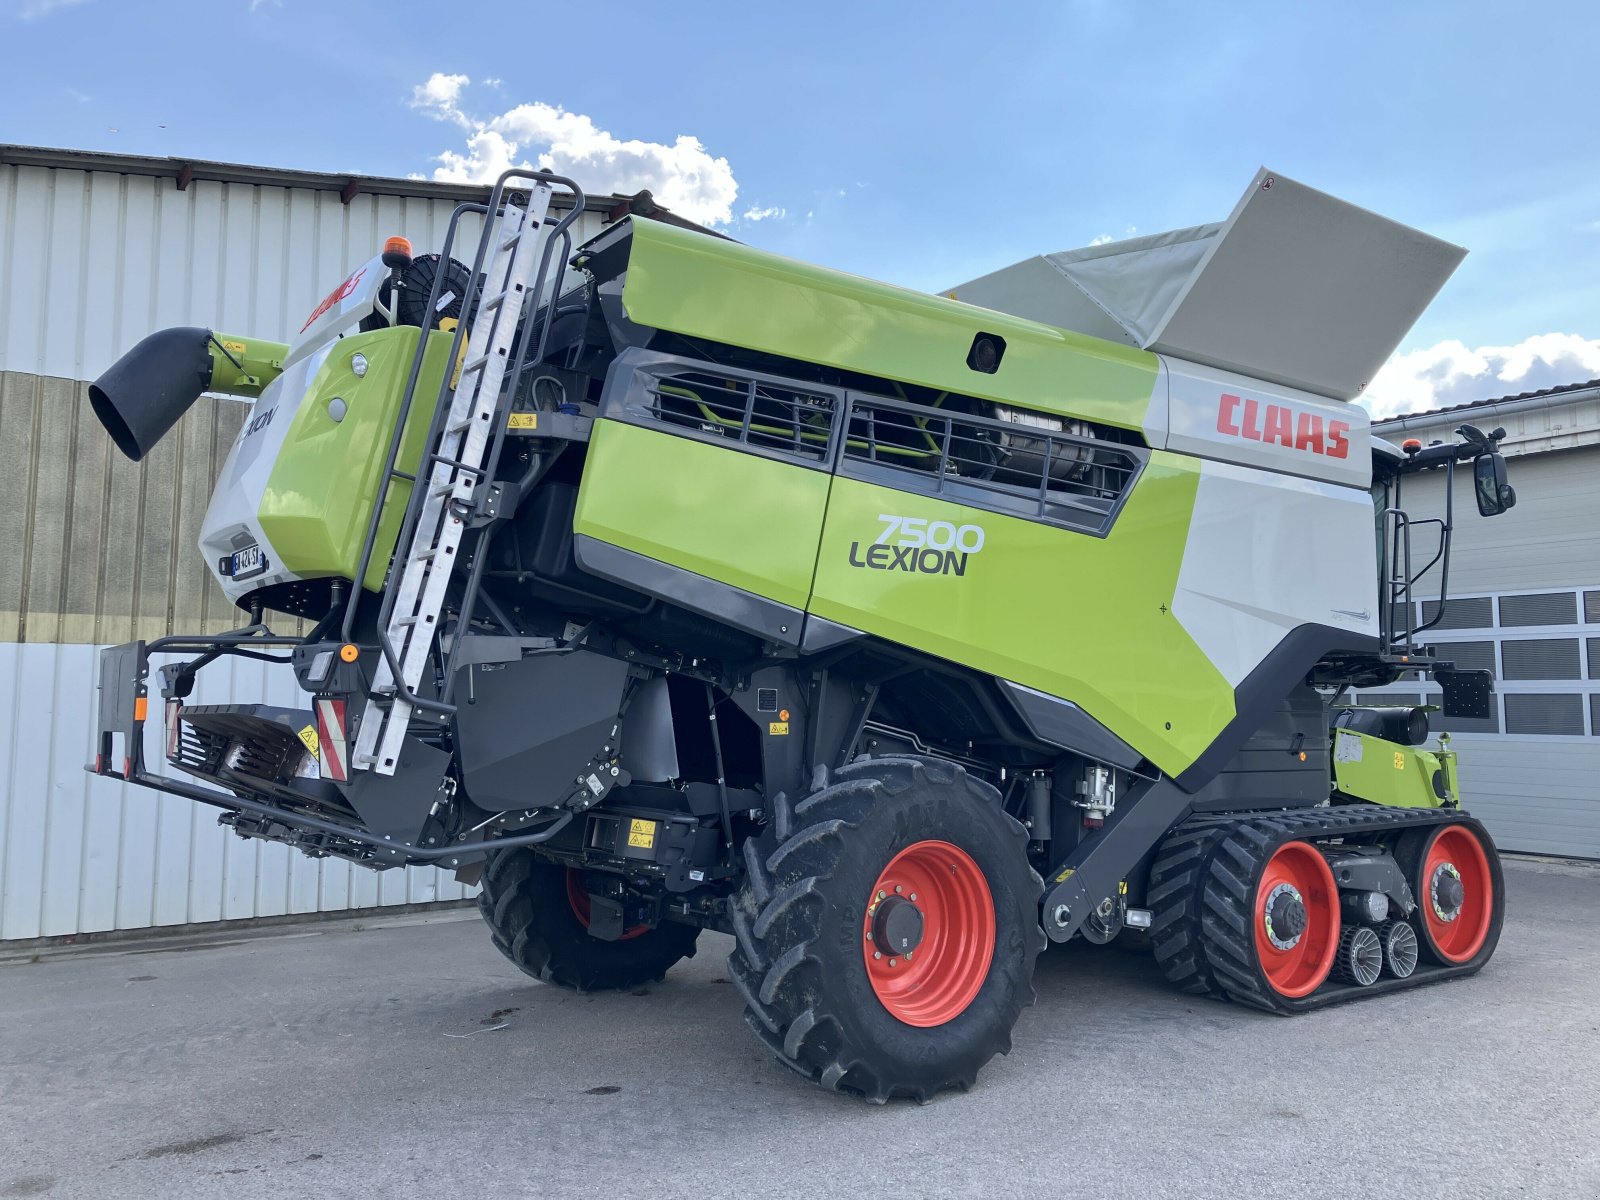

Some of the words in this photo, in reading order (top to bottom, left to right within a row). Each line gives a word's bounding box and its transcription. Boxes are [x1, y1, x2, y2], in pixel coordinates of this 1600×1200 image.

[1217, 394, 1349, 460] CLAAS
[875, 514, 985, 553] 7500
[849, 542, 968, 576] LEXION
